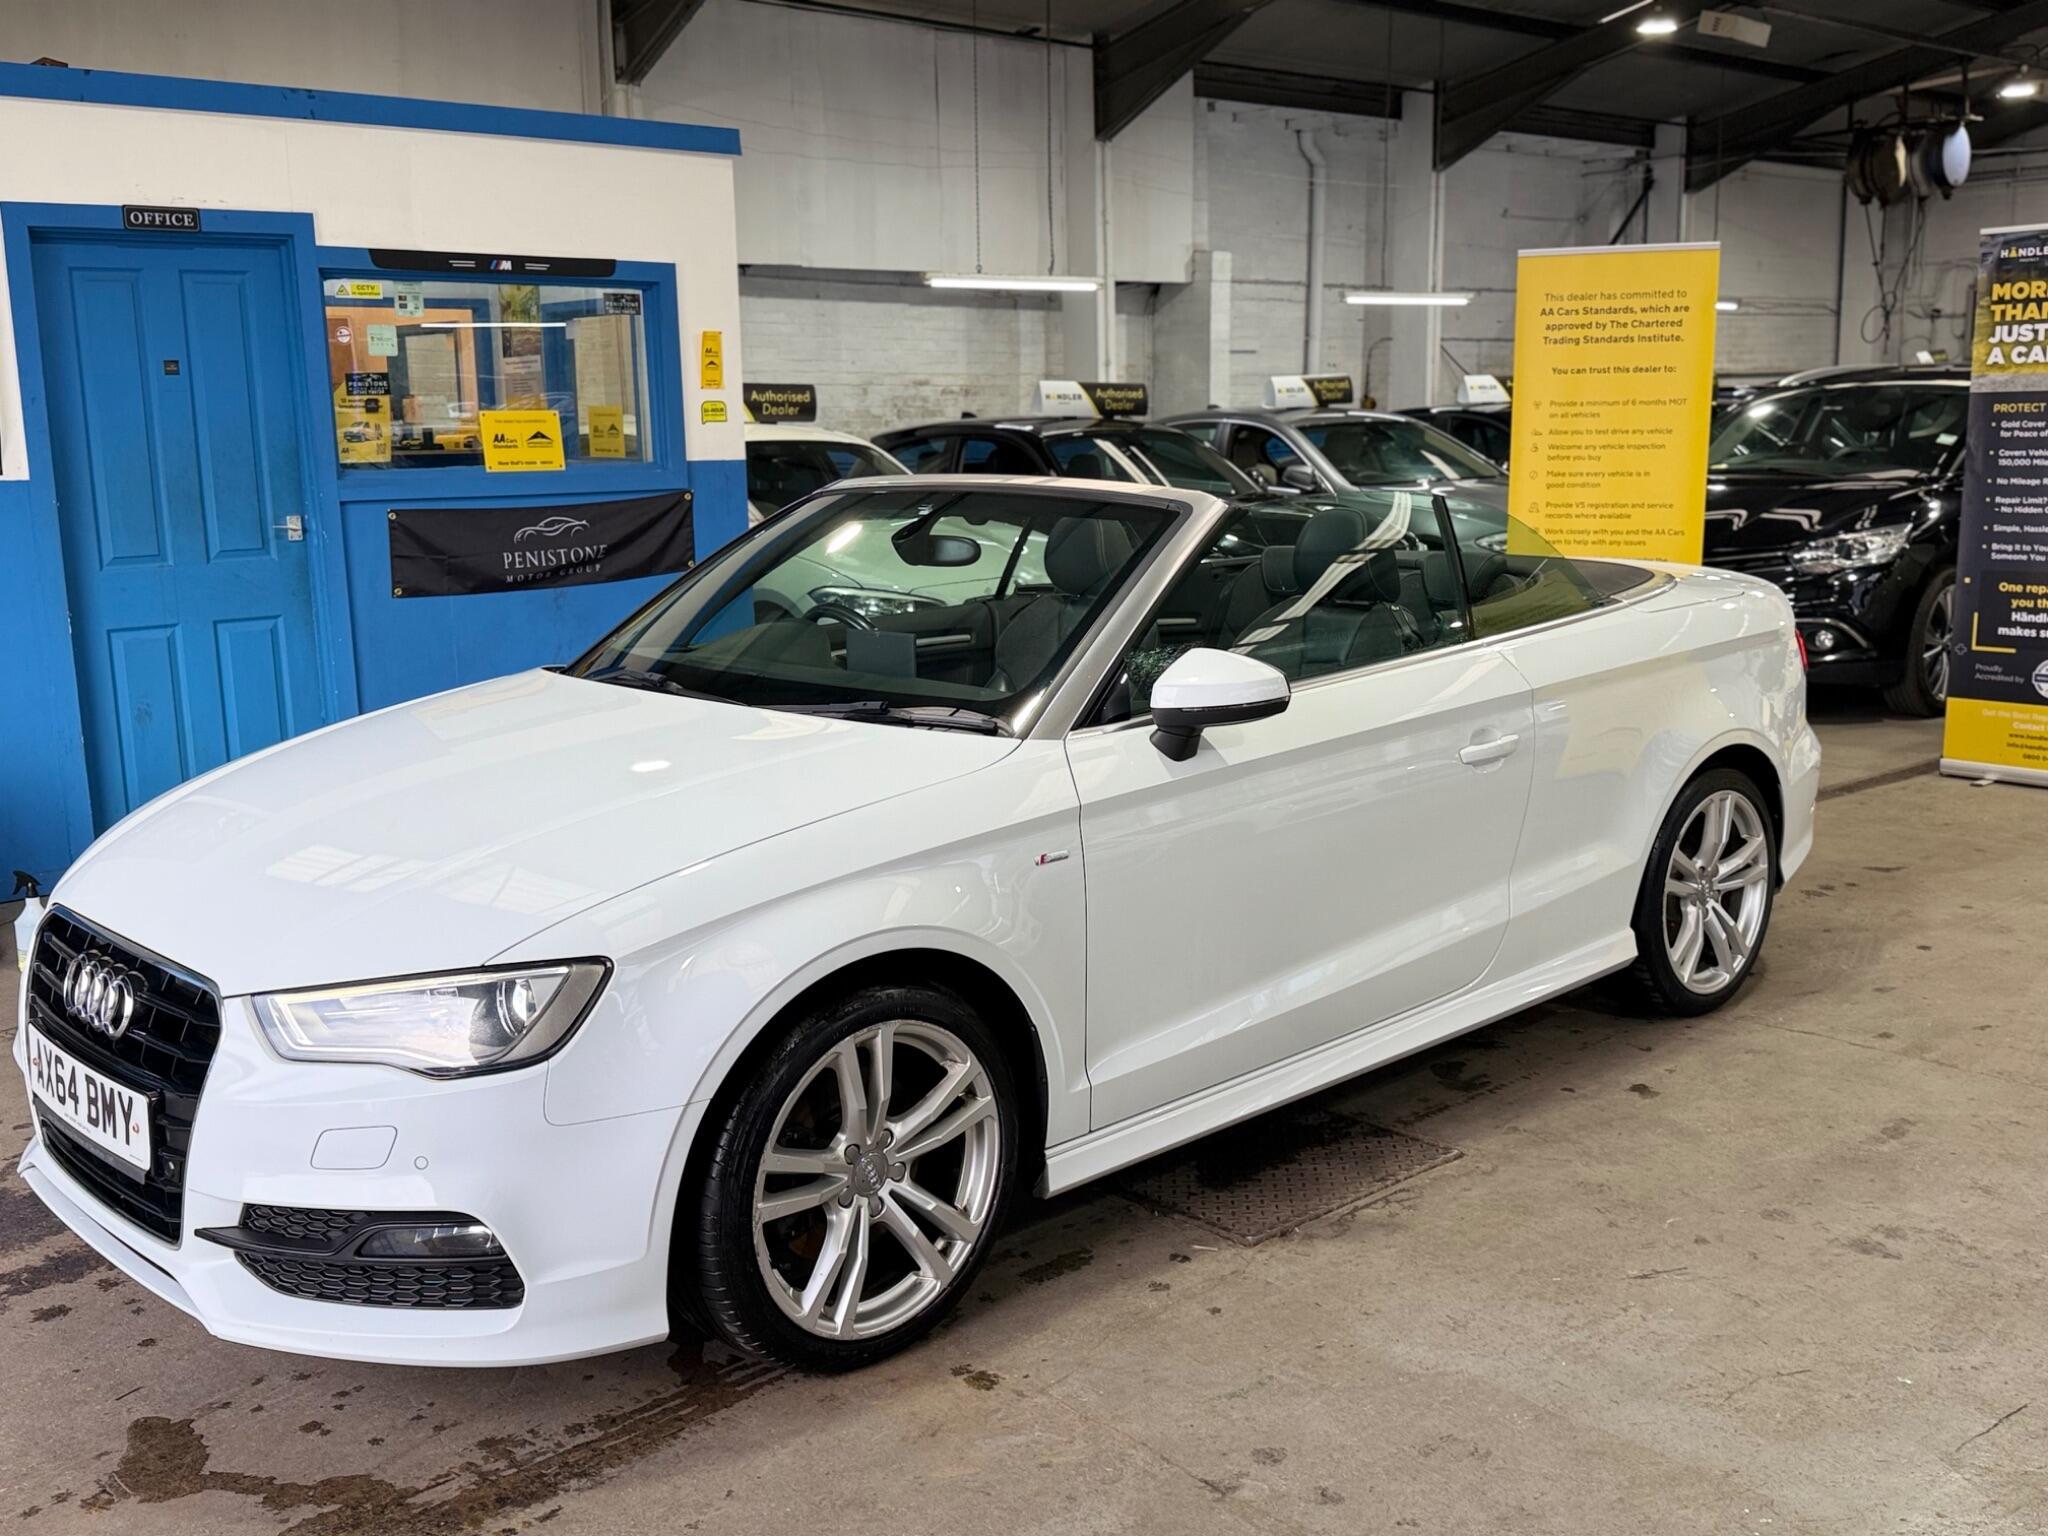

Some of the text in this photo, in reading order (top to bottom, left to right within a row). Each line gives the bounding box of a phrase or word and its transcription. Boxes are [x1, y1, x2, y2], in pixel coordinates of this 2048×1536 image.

[129, 211, 195, 227] OFFICE
[1544, 289, 1688, 302] This dealer has committed to
[1991, 280, 2048, 301] MOR
[1540, 304, 1690, 317] AA Cars Standards, which are
[1545, 318, 1683, 332] approved by The Chartered
[1988, 323, 2048, 344] JUST
[1543, 333, 1684, 347] Trading Standards Institute.
[1985, 344, 2048, 366] A CA
[1551, 364, 1677, 375] You can trust this dealer to:
[750, 389, 811, 402] Authorised
[1095, 387, 1144, 399] Authorised
[1104, 399, 1135, 410] Dealer
[1549, 399, 1577, 407] Provide
[1586, 399, 1620, 407] minimum
[1622, 398, 1630, 406] of
[1631, 398, 1637, 406] 6
[1638, 398, 1667, 406] months
[1668, 397, 1688, 405] MOT
[1993, 402, 2047, 413] PROTECT
[762, 403, 800, 415] Dealer
[2000, 420, 2047, 428] Gold Cover
[493, 433, 506, 444] AA
[1570, 429, 1584, 437] you
[2000, 429, 2012, 437] for
[1626, 442, 1666, 451] inspection
[1588, 454, 1601, 462] buy
[1998, 448, 2027, 457] Covers
[1998, 458, 2031, 467] 150,000
[1545, 481, 1565, 489] good
[1996, 477, 2008, 485] No
[2010, 477, 2041, 486] Mileage
[1545, 501, 1573, 509] Provide
[1587, 501, 1629, 510] registration
[1995, 496, 2048, 504] Repair Limit?
[2014, 506, 2043, 514] Hidden
[1565, 528, 1591, 536] closely
[1625, 528, 1639, 536] and
[1641, 528, 1653, 536] the
[1654, 528, 1666, 536] AA
[1667, 528, 1685, 536] Cars
[1993, 524, 2022, 533] Simple,
[1573, 538, 1588, 546] help
[1591, 538, 1607, 546] with
[1608, 539, 1621, 547] any
[1991, 543, 2013, 552] Bring
[503, 544, 608, 570] PENISTONE
[1991, 552, 2047, 561] Someone You
[505, 563, 601, 583] MOTOR GROUP
[1998, 582, 2024, 593] One
[2010, 599, 2035, 609] you
[2011, 611, 2048, 623] Händl
[1997, 626, 2038, 638] makes
[1975, 663, 2003, 673] Proudly
[1974, 673, 2014, 682] Accredited
[2015, 675, 2025, 684] by
[36, 1037, 134, 1146] AX64 BMY
